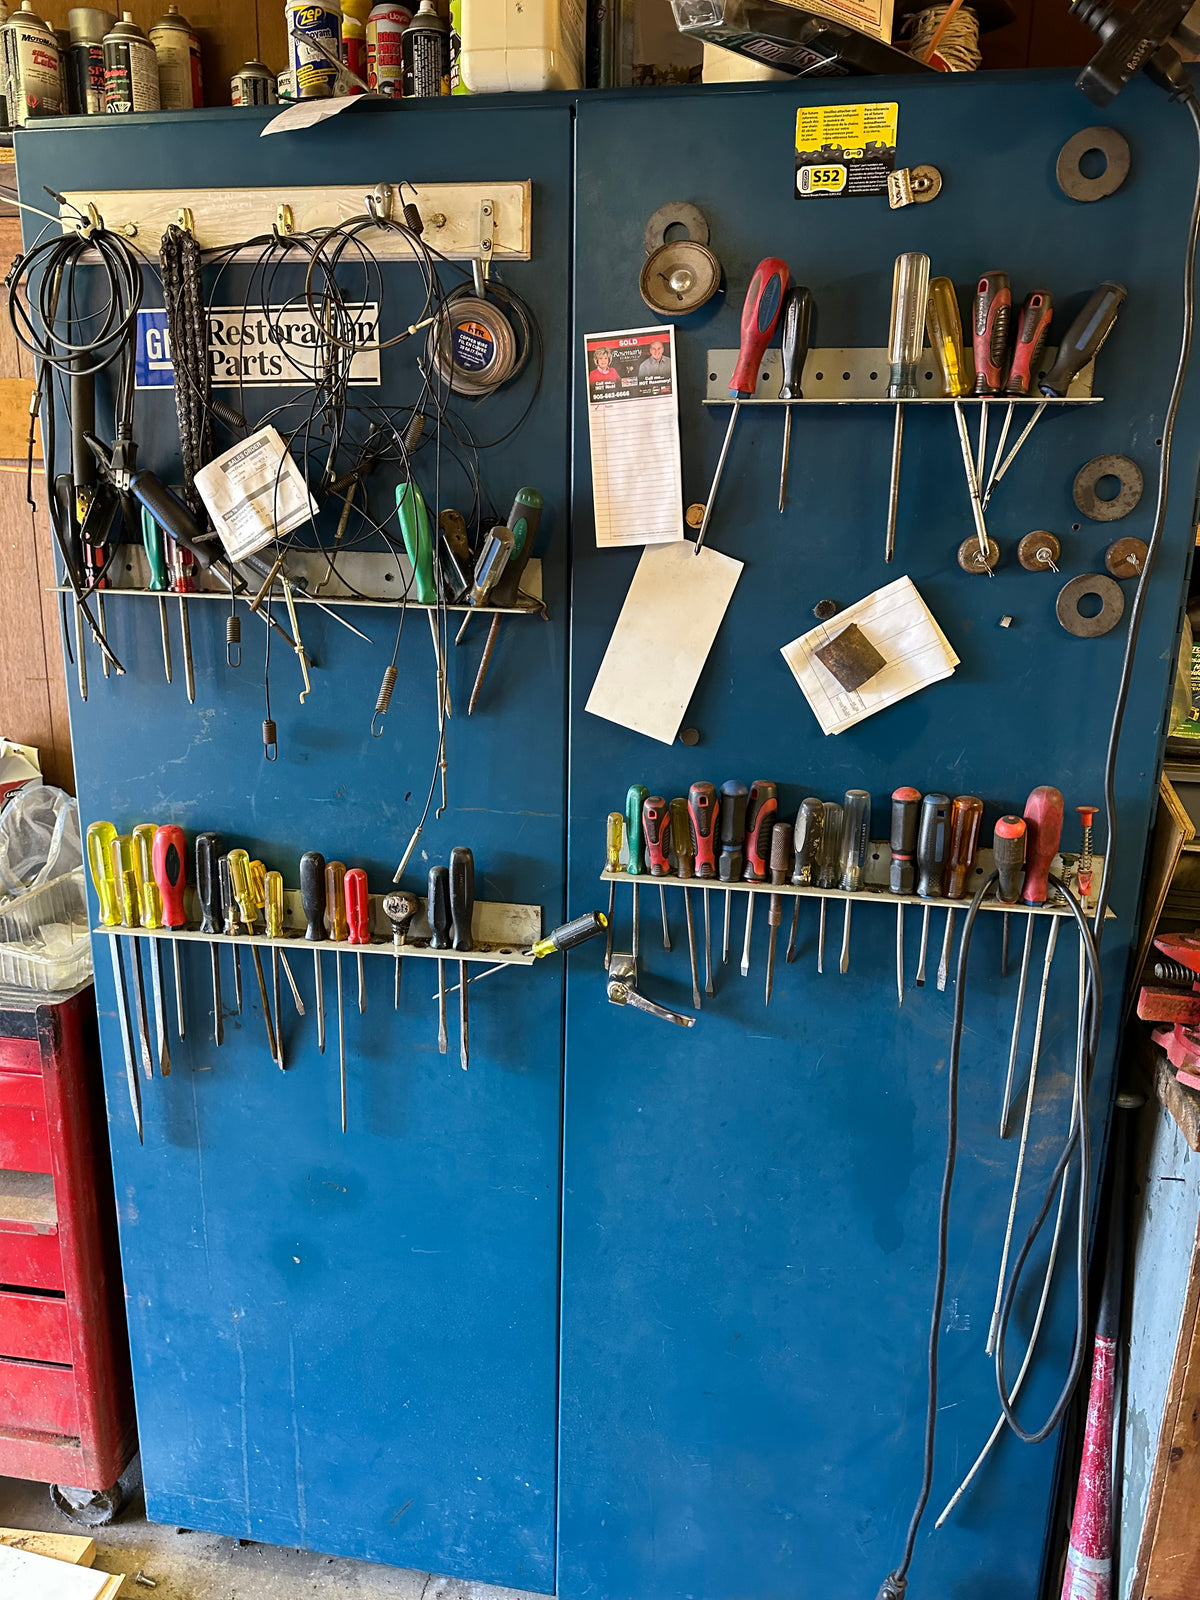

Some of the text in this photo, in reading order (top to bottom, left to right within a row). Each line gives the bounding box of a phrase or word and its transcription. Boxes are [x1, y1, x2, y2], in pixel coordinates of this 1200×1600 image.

[813, 170, 840, 183] S52
[618, 338, 638, 347] SOLD
[209, 350, 282, 376] Parts
[227, 442, 261, 467] SALES ORDER
